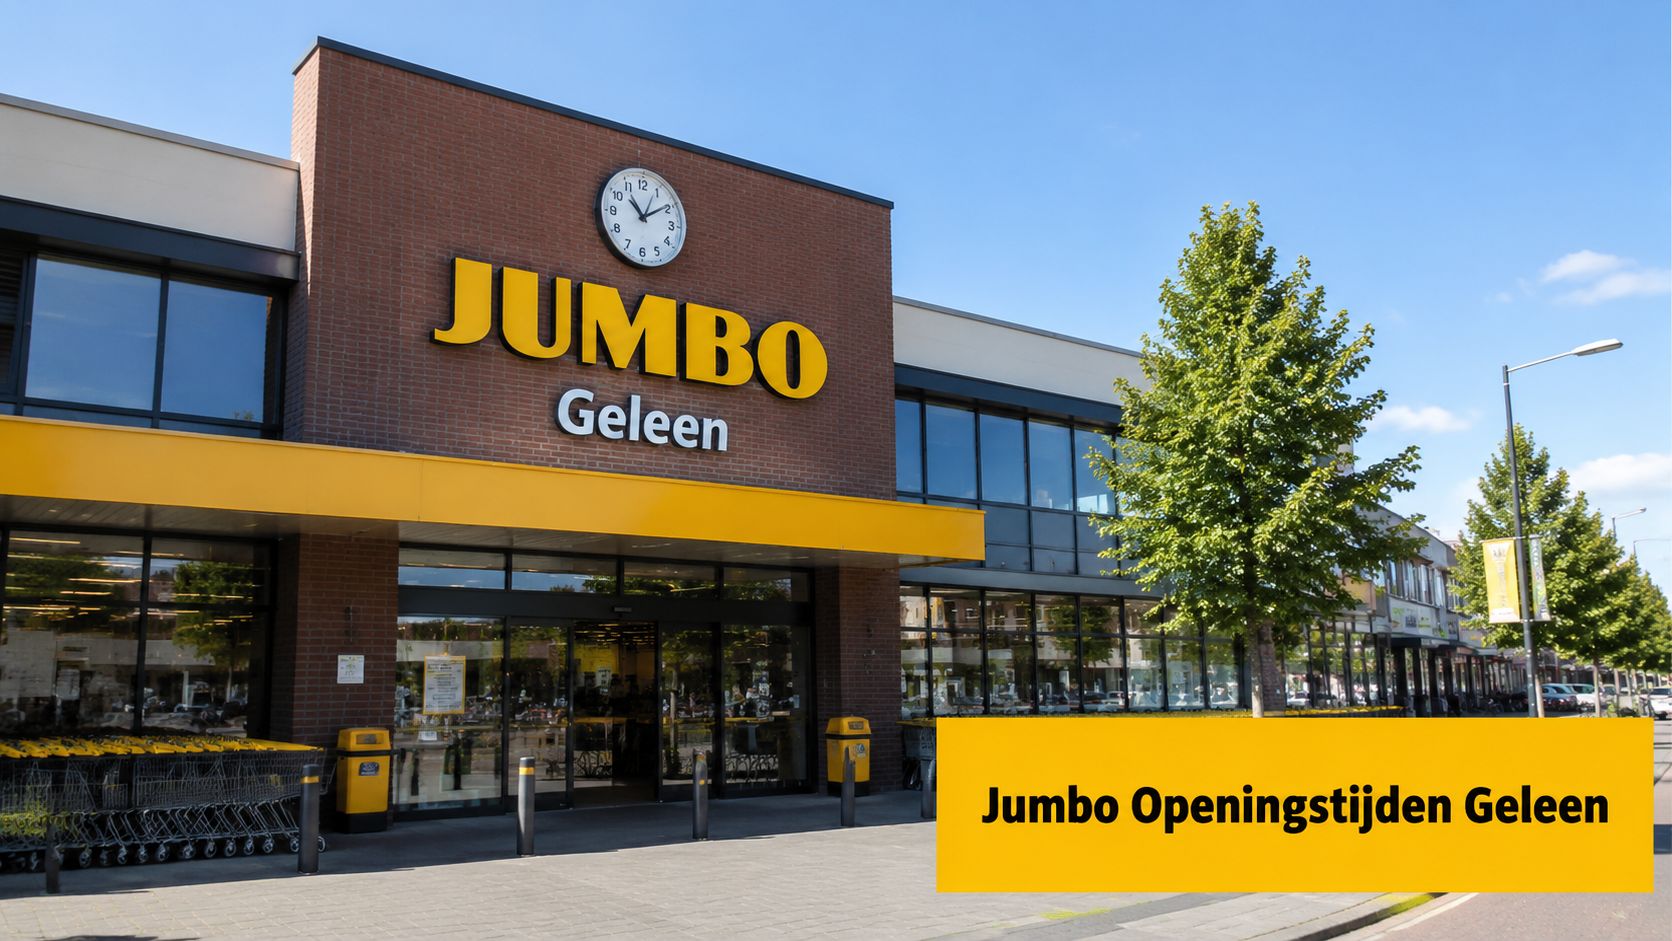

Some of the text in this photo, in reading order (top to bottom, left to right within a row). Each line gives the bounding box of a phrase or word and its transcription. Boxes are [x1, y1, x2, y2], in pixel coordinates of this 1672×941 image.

[624, 181, 632, 192] 11
[638, 179, 648, 191] 12
[612, 190, 623, 201] 10
[655, 187, 659, 198] 1
[609, 205, 617, 216] 9
[664, 204, 671, 214] 2
[613, 223, 621, 233] 8
[668, 220, 675, 231] 3
[625, 238, 632, 249] 7
[663, 236, 670, 246] 4
[639, 247, 646, 258] 6
[653, 246, 660, 257] 5
[432, 257, 828, 399] JUMBO
[556, 388, 728, 452] Geleen
